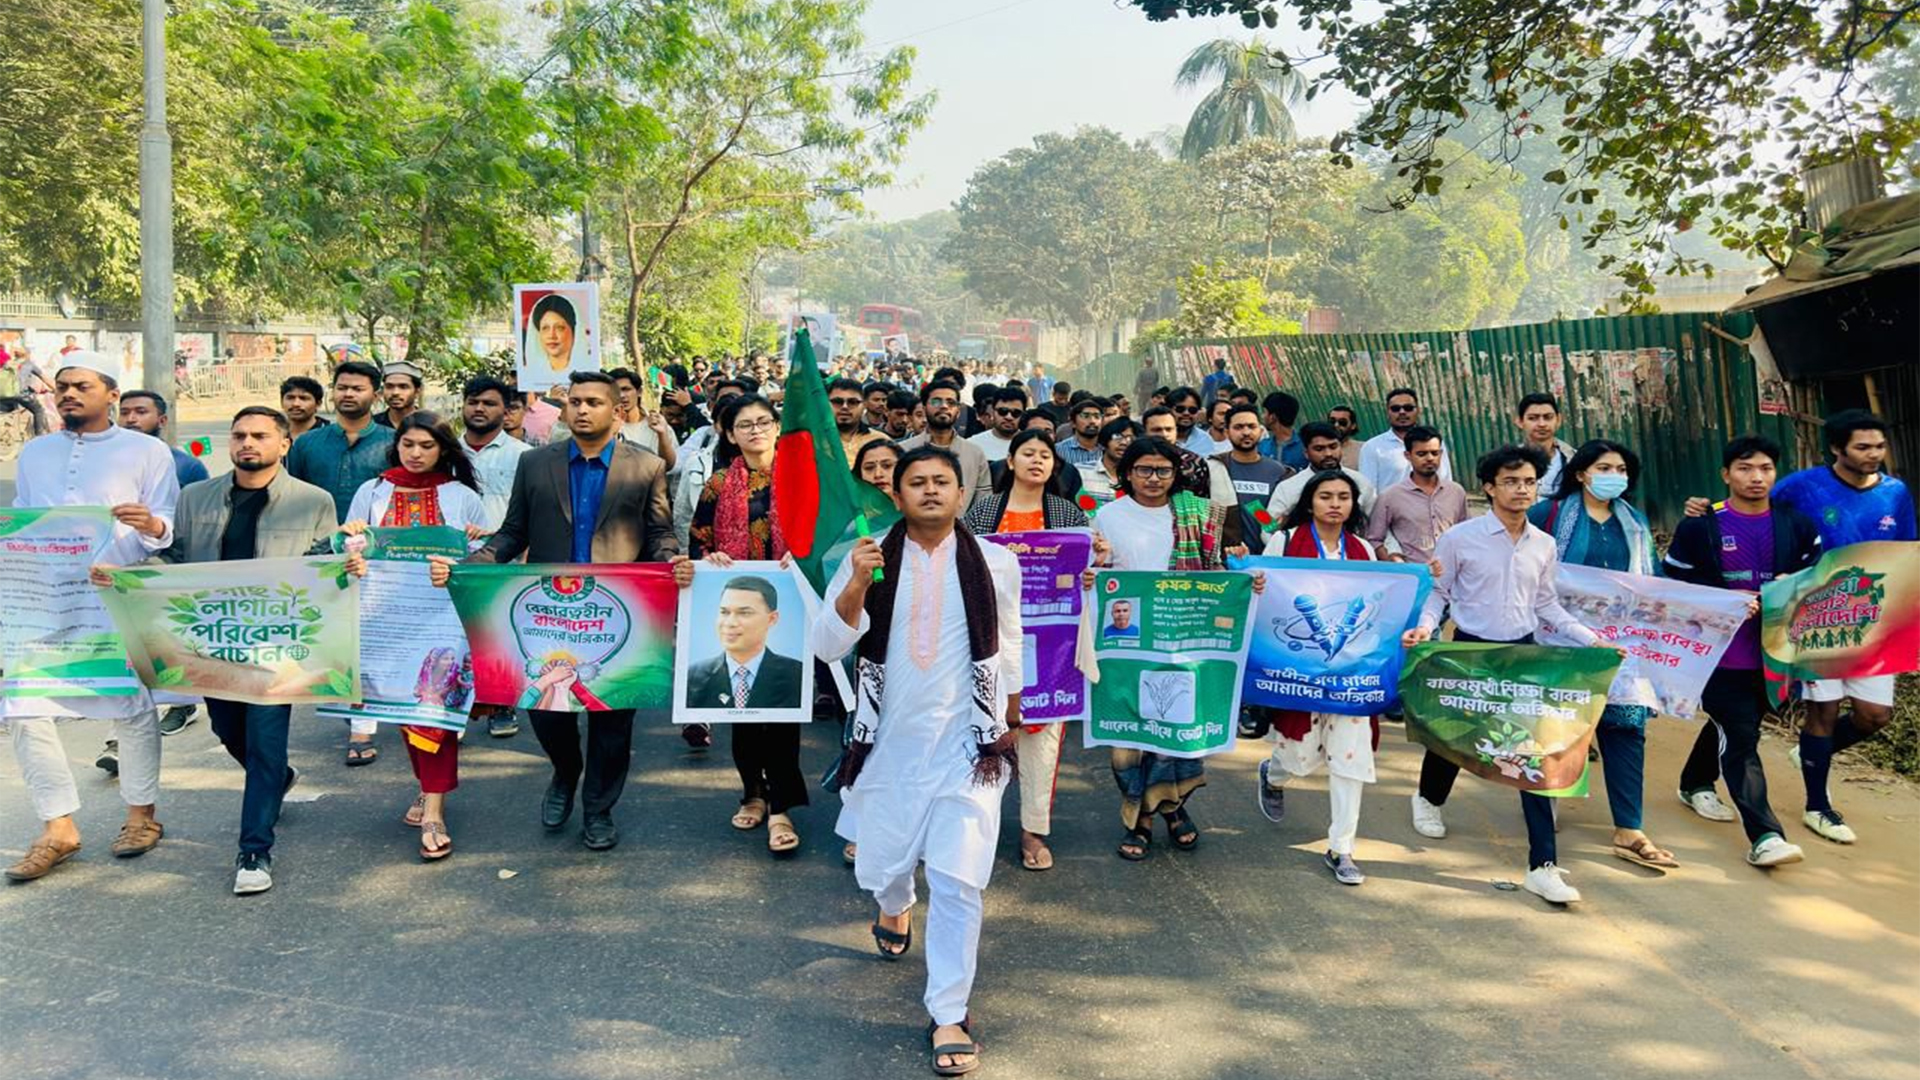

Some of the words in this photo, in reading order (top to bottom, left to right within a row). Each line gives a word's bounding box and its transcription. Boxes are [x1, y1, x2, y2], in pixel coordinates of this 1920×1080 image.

[1155, 579, 1192, 594] কৃষক
[1196, 580, 1229, 594] কার্ড
[200, 599, 288, 617] লাগান
[525, 602, 613, 619] বেকারত্বহীন
[191, 618, 299, 645] পরিবেশ
[533, 614, 605, 632] বাংলাদেশ
[522, 627, 566, 641] আমাদের
[1255, 679, 1323, 699] আমাদের
[1314, 675, 1337, 687] গণ
[1500, 680, 1545, 698] শিক্ষা
[1438, 695, 1507, 714] আমাদের
[1099, 720, 1138, 732] ধানের
[1143, 719, 1172, 739] শীষে
[1177, 725, 1203, 741] ভোট
[1205, 721, 1224, 736] দিন
